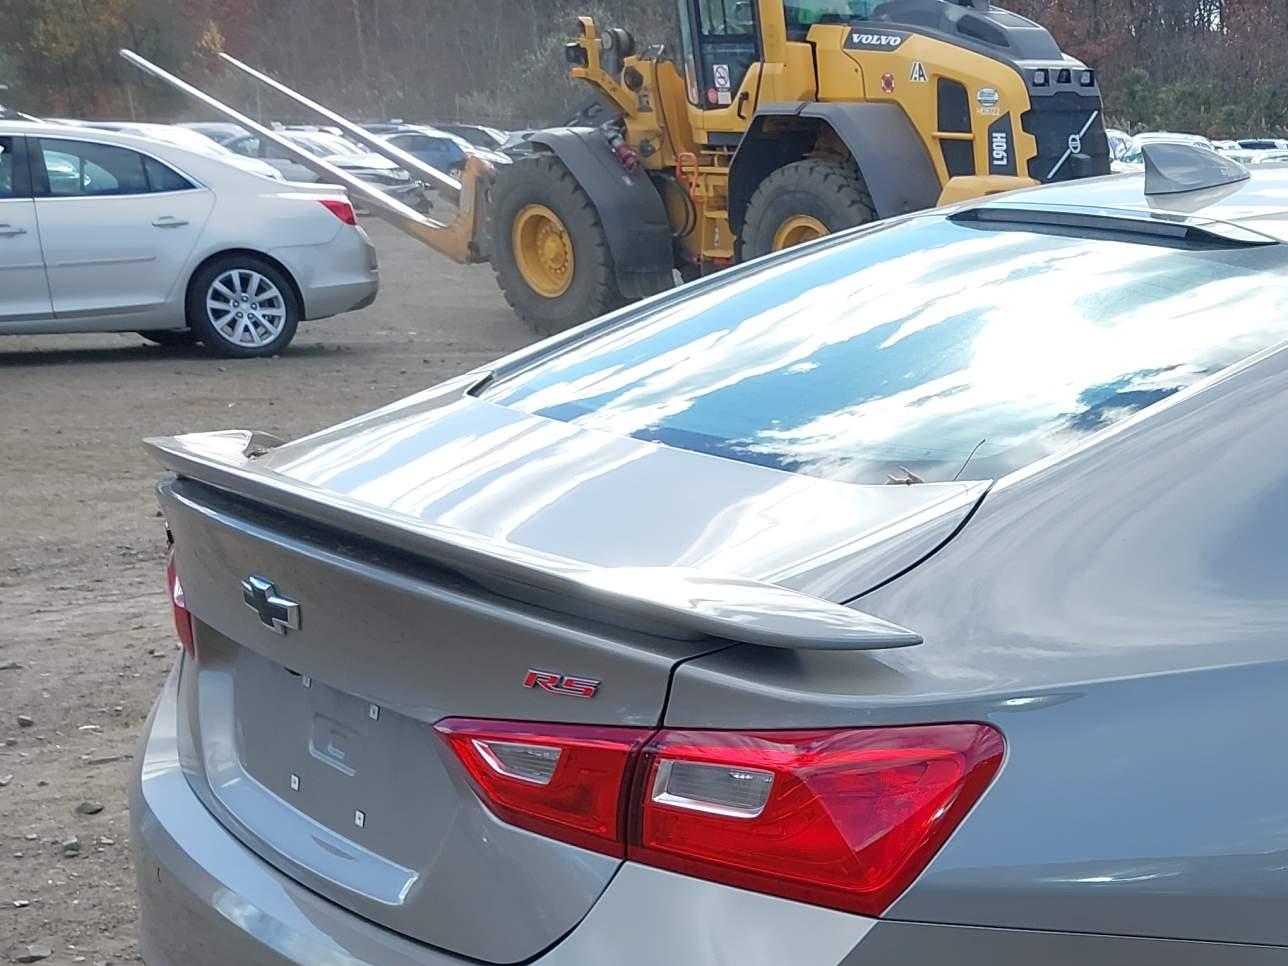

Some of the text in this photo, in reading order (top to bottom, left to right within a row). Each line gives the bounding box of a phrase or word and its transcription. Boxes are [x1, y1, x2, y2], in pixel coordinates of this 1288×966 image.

[852, 33, 902, 46] VOLVO
[992, 132, 1008, 165] L90H
[523, 667, 600, 698] RS
